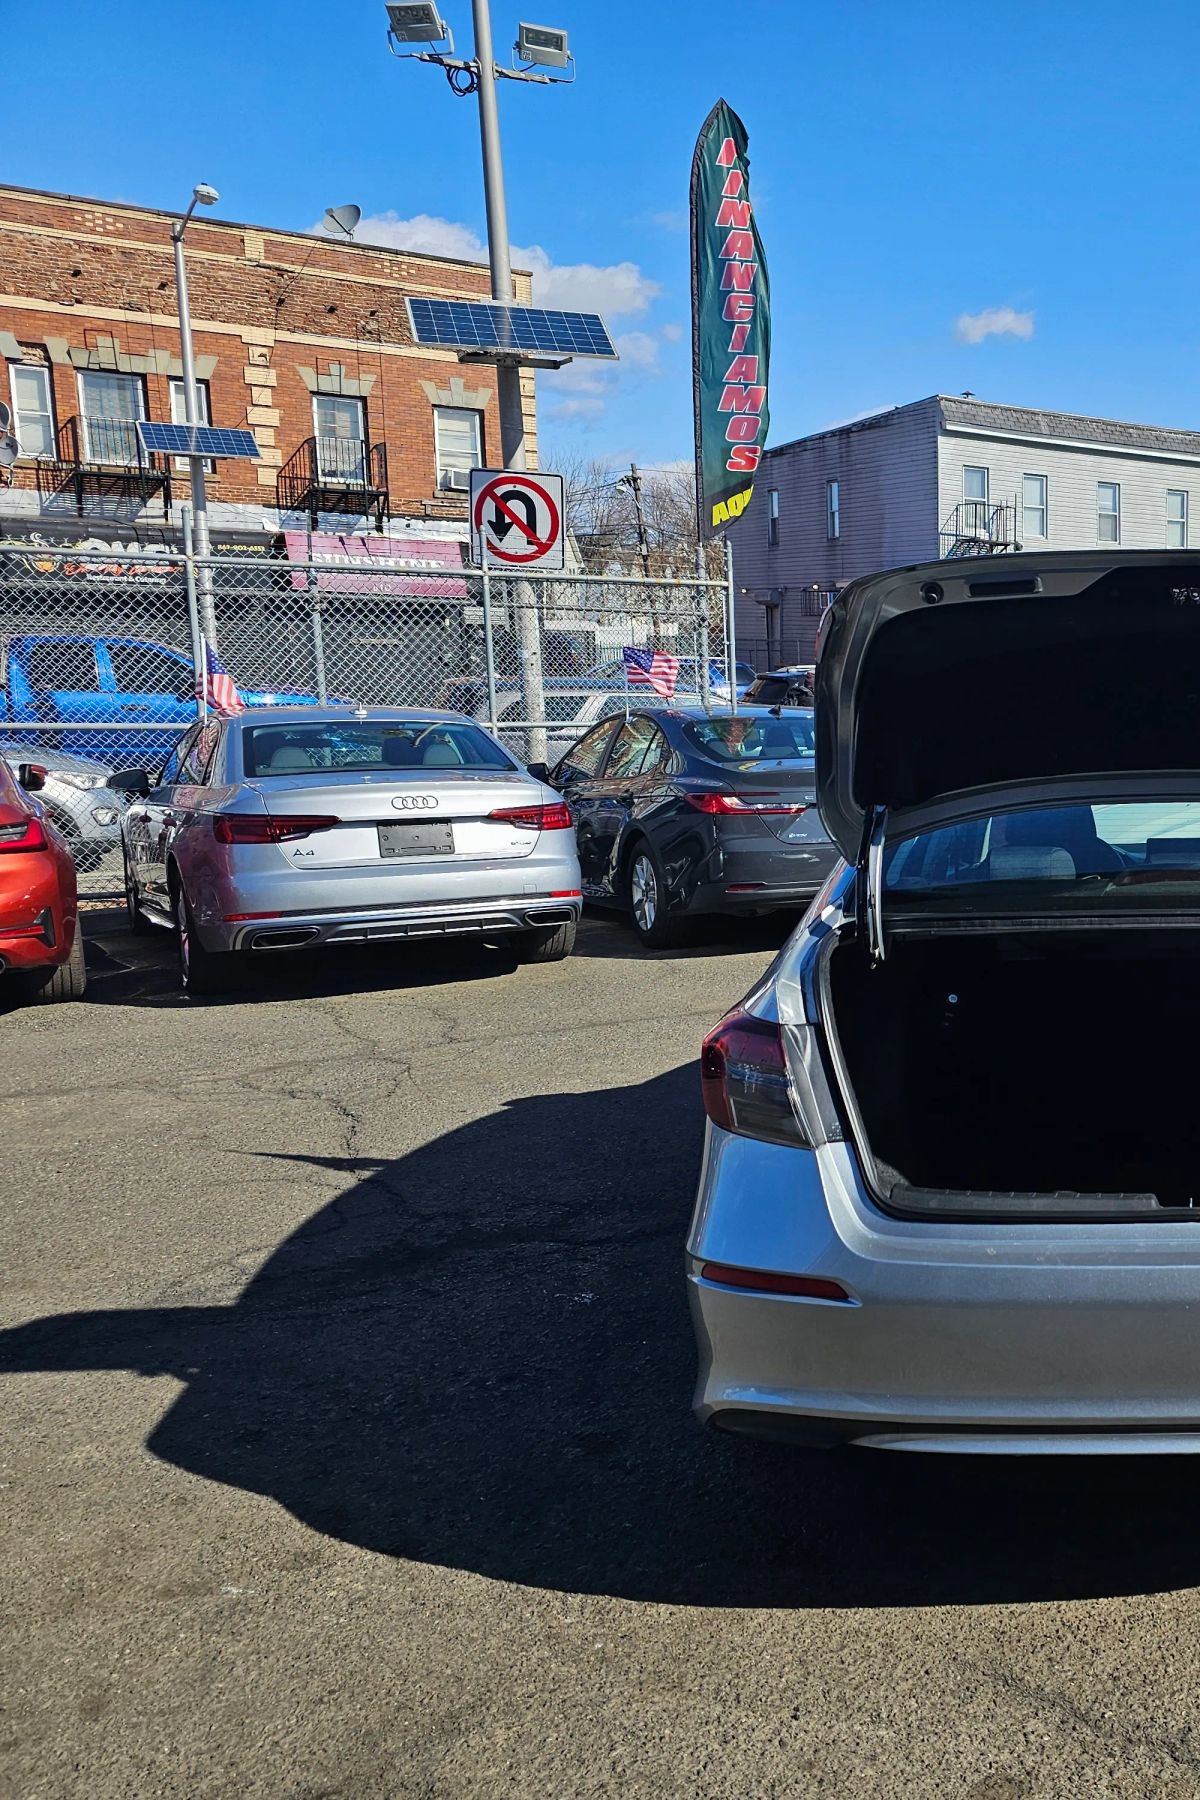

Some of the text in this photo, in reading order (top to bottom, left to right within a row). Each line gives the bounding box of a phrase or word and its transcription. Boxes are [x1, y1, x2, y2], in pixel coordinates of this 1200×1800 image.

[712, 484, 754, 527] AQU
[312, 553, 445, 569] SUNSHINE
[293, 848, 314, 857] A4
